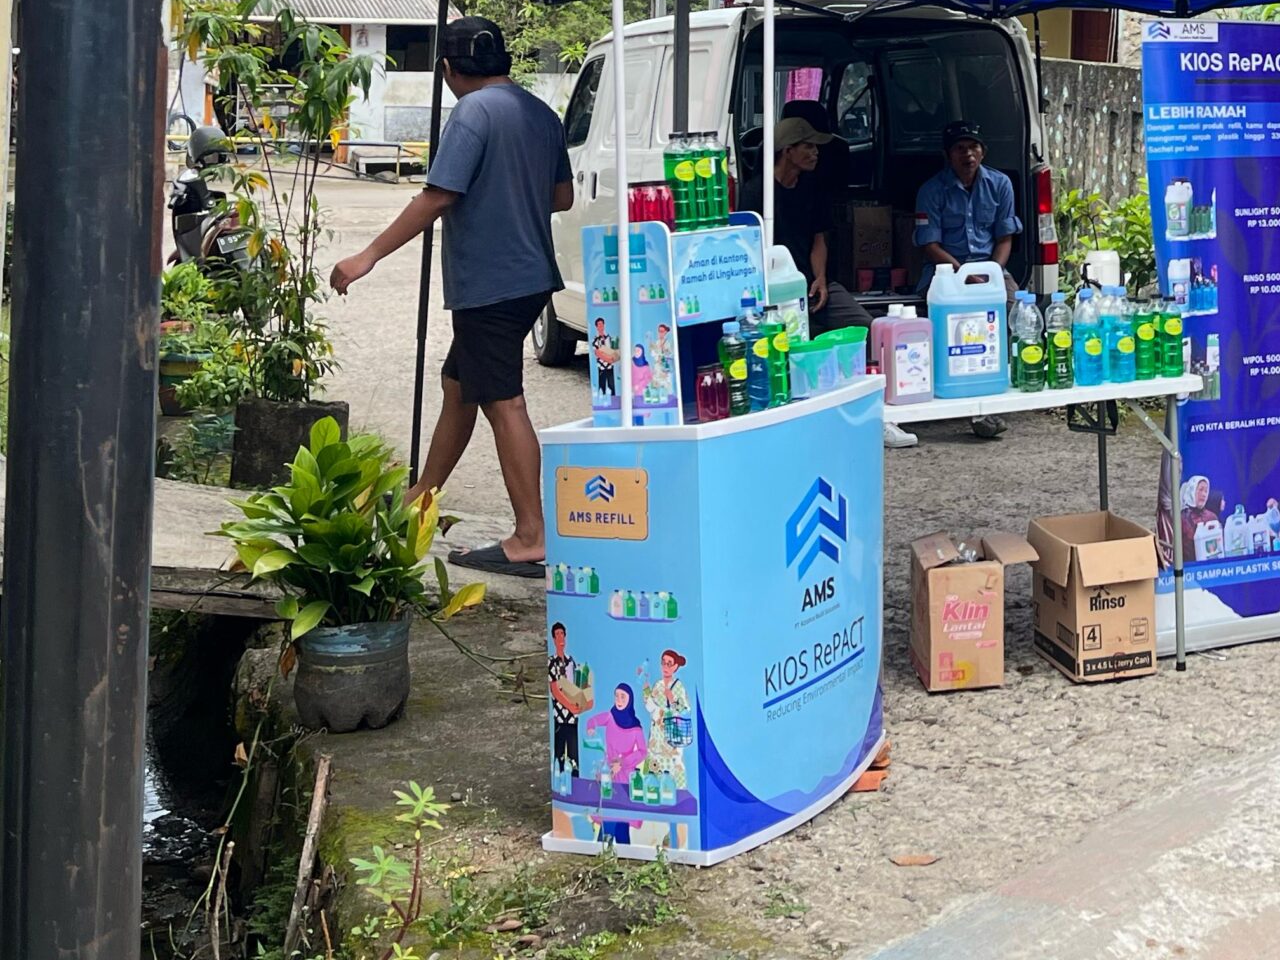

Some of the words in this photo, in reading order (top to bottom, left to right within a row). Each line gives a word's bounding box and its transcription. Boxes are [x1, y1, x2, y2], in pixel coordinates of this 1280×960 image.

[1182, 23, 1206, 35] AMS
[1180, 52, 1224, 72] KIOS
[1150, 106, 1194, 120] LEBIH
[1196, 105, 1247, 119] RAMAH
[1235, 208, 1269, 217] SUNLIGHT
[1247, 219, 1257, 228] RP
[688, 259, 710, 269] Aman
[711, 255, 718, 266] di
[718, 253, 748, 263] Kantong
[681, 272, 707, 284] Ramah
[708, 270, 715, 281] di
[716, 267, 757, 280] Lingkungan
[1243, 274, 1264, 283] RINSO
[1266, 273, 1280, 282] 500
[1243, 356, 1265, 365] WIPOL
[1266, 354, 1280, 363] 500
[1250, 368, 1259, 376] RP
[1190, 423, 1205, 433] AYO
[1205, 421, 1224, 431] KITA
[1225, 419, 1256, 430] BERALIH
[1256, 418, 1266, 427] KE
[569, 511, 592, 523] AMS
[595, 512, 635, 525] REFILL
[1197, 568, 1234, 581] SAMPAH
[1236, 563, 1270, 575] PLASTIK
[801, 576, 835, 612] AMS
[1090, 596, 1125, 611] Rinso
[942, 600, 990, 623] Klin
[1087, 627, 1097, 642] 4
[765, 650, 808, 696] KIOS
[814, 616, 864, 673] RePACT
[1108, 660, 1114, 669] L
[1134, 655, 1150, 665] Can)
[766, 696, 801, 723] Reducing
[802, 672, 847, 707] Environmental
